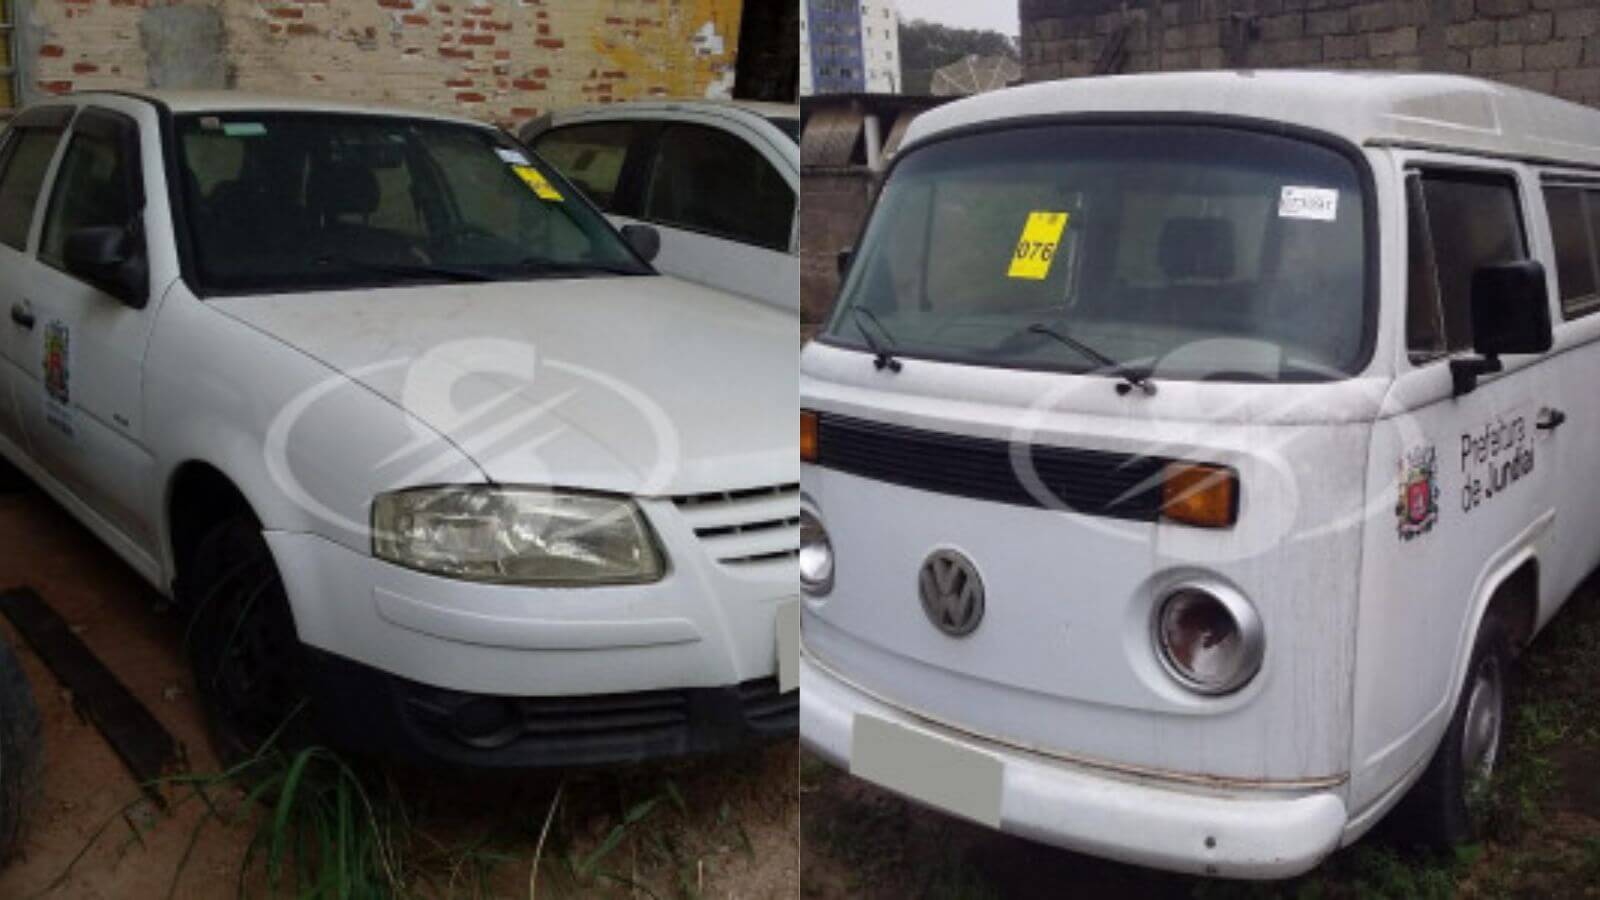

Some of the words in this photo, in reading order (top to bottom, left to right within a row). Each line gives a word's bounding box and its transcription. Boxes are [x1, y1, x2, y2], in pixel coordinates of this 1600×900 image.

[1016, 241, 1055, 262] 076
[1461, 415, 1525, 473] Prefeitura
[1461, 473, 1481, 513] de
